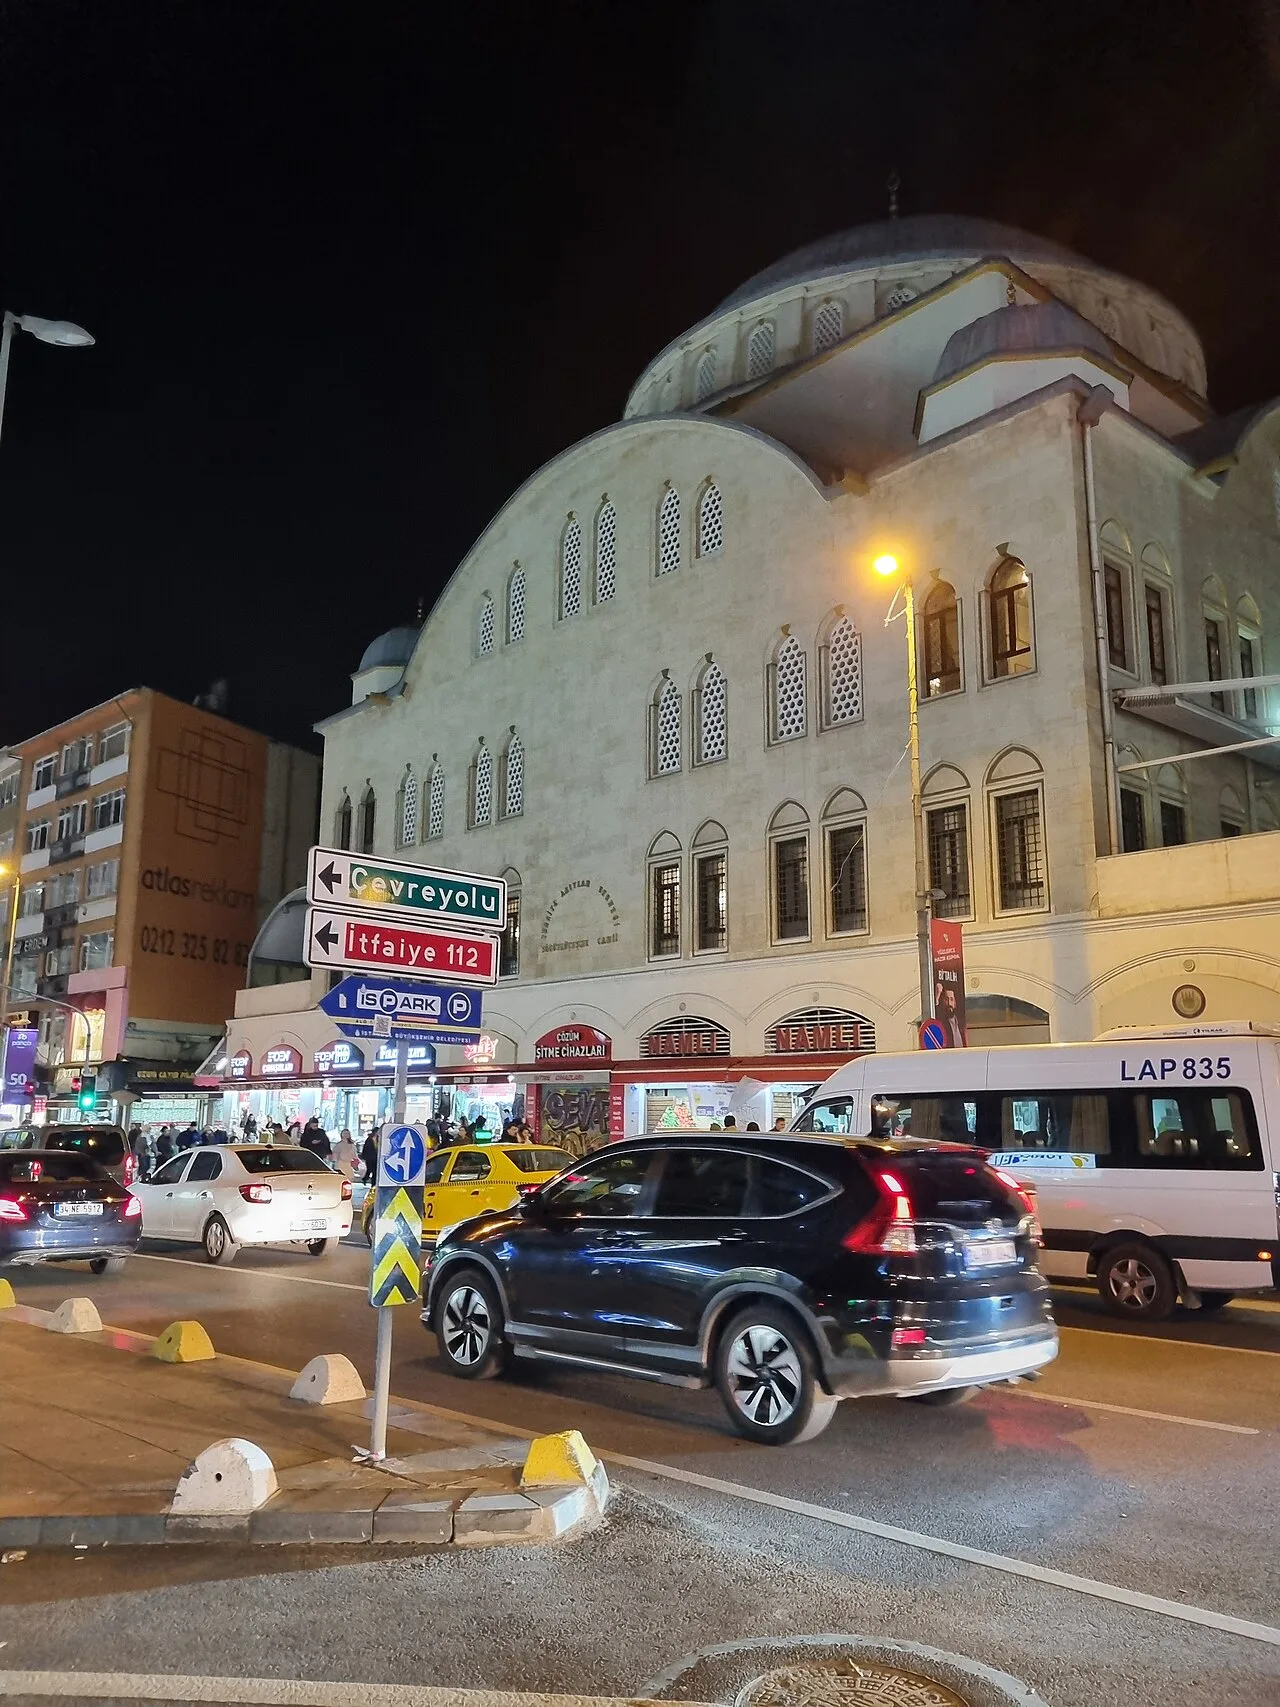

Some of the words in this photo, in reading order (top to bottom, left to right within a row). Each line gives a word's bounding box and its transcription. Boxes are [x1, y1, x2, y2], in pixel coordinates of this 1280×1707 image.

[351, 867, 496, 912] Çevreyolu
[141, 925, 175, 956] 0212
[182, 932, 207, 961] 325
[349, 923, 436, 966] İtfaiye
[446, 943, 478, 968] 112
[556, 1030, 580, 1043] ÇÖZÜM
[648, 1031, 717, 1054] NAMLI
[776, 1024, 862, 1051] NAMLI
[561, 1043, 605, 1057] CİHAZLARI
[1120, 1058, 1177, 1081] LAP
[1182, 1057, 1231, 1080] 835
[71, 1205, 79, 1213] NE
